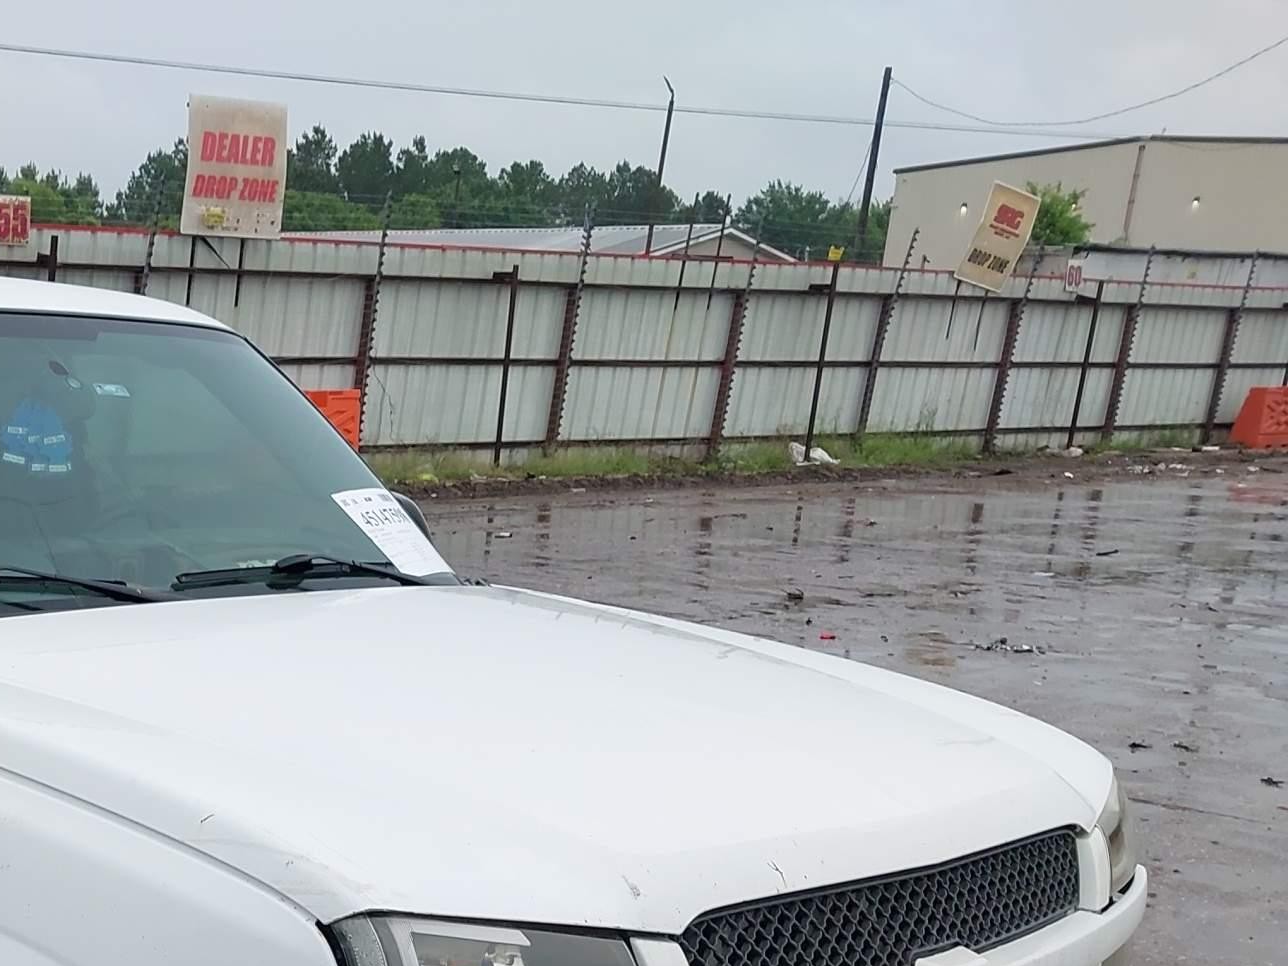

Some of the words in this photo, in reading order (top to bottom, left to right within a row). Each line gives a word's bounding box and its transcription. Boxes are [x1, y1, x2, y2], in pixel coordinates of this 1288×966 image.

[200, 131, 276, 167] DEALER
[192, 174, 238, 200] DROP
[238, 177, 279, 203] ZONE
[967, 248, 992, 267] DROP
[987, 255, 1010, 274] ZONE
[1067, 265, 1082, 286] 60
